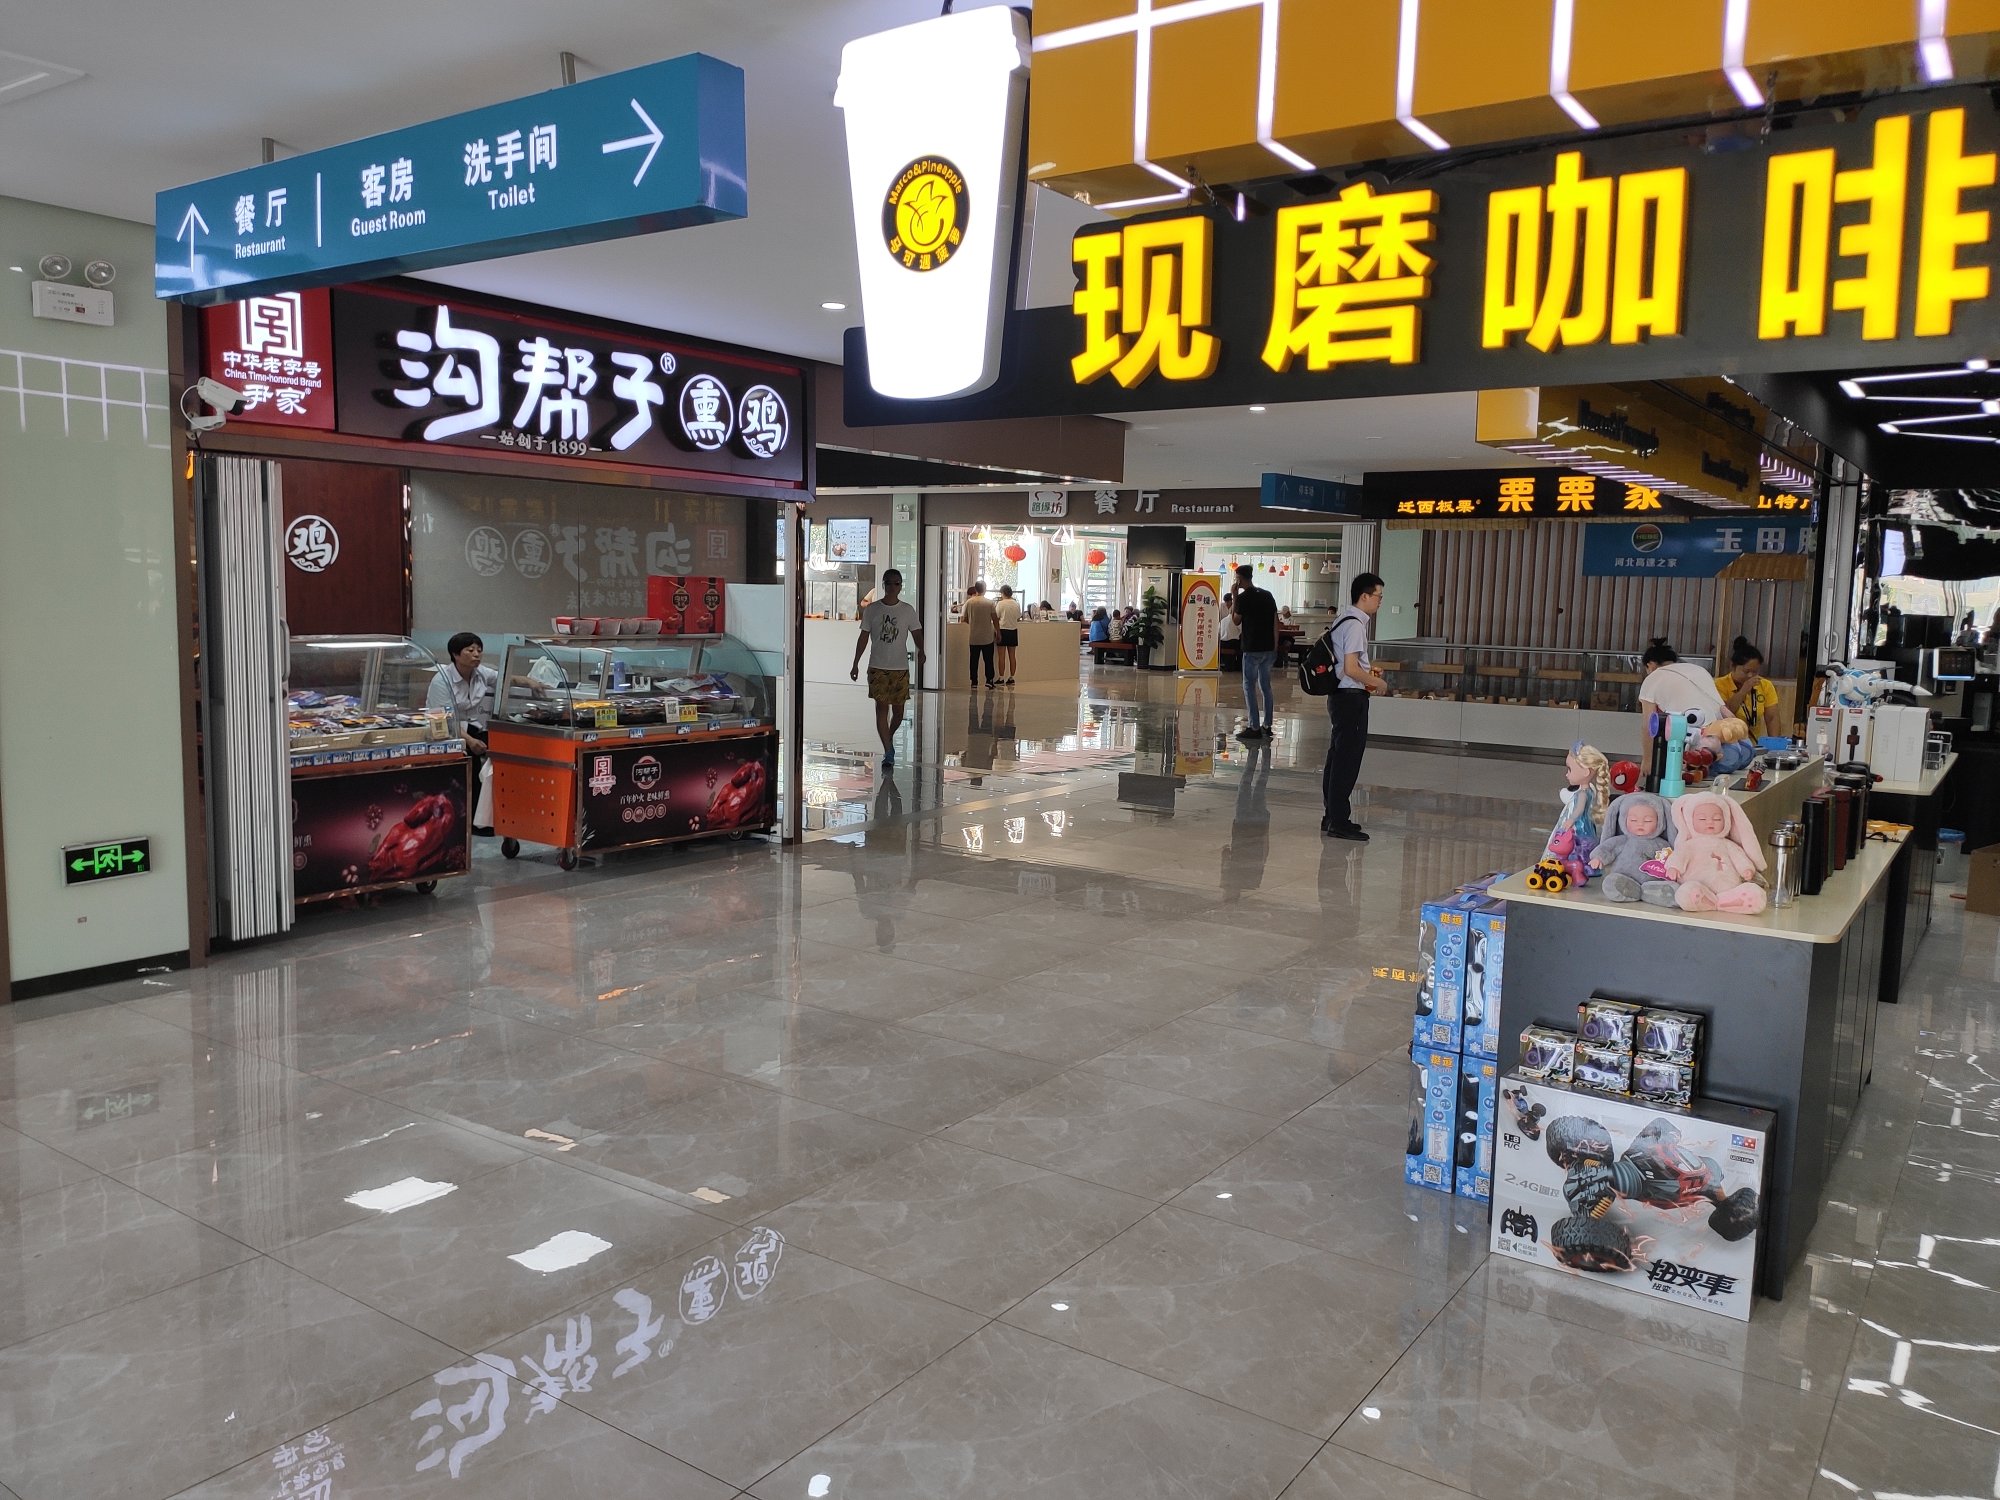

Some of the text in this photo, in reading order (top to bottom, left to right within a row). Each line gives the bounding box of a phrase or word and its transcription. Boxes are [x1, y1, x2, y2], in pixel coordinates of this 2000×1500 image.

[463, 124, 557, 187] 洗手间
[361, 157, 414, 209] 客房
[488, 183, 536, 210] Toilet
[234, 187, 287, 236] 餐厅
[351, 208, 426, 237] Guest Room
[235, 235, 286, 259] Restaurant
[1071, 107, 1996, 389] 现磨咖啡
[223, 351, 322, 378] 中华老字号
[224, 368, 322, 388] China Time-honored Brand
[394, 305, 786, 453] 沟帮子 熏鸡
[1094, 488, 1160, 514] 餐厅
[1171, 503, 1235, 513] Restaurant
[1398, 499, 1475, 514] 迁西板栗
[287, 518, 335, 569] 鸡
[1614, 557, 1678, 568] 河北高速之家
[1503, 1134, 1520, 1144] 1:8
[1503, 1141, 1520, 1151] R/C
